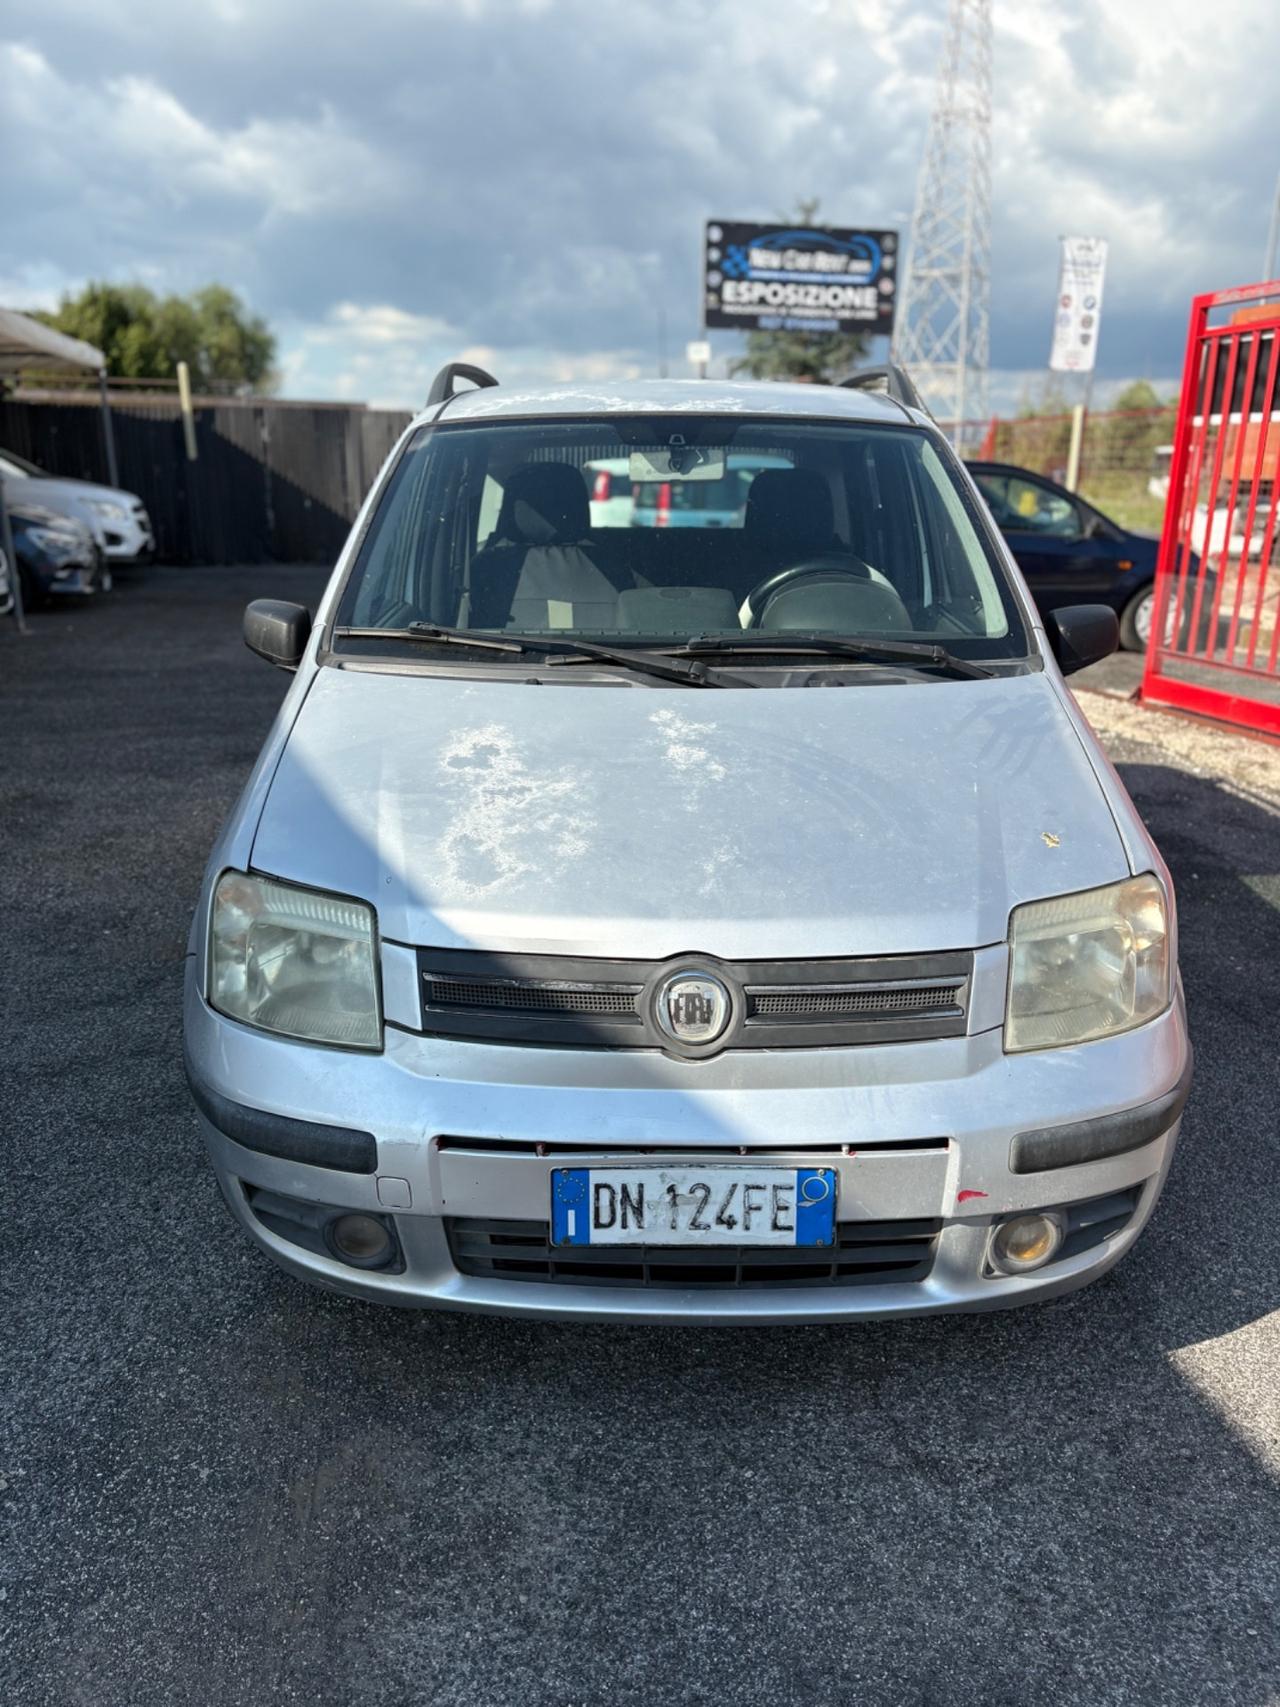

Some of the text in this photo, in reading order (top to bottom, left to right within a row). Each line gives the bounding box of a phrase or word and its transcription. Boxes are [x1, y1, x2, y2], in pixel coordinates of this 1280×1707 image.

[722, 280, 878, 309] ESPOSIZIONE
[593, 1182, 795, 1231] DN 124FE
